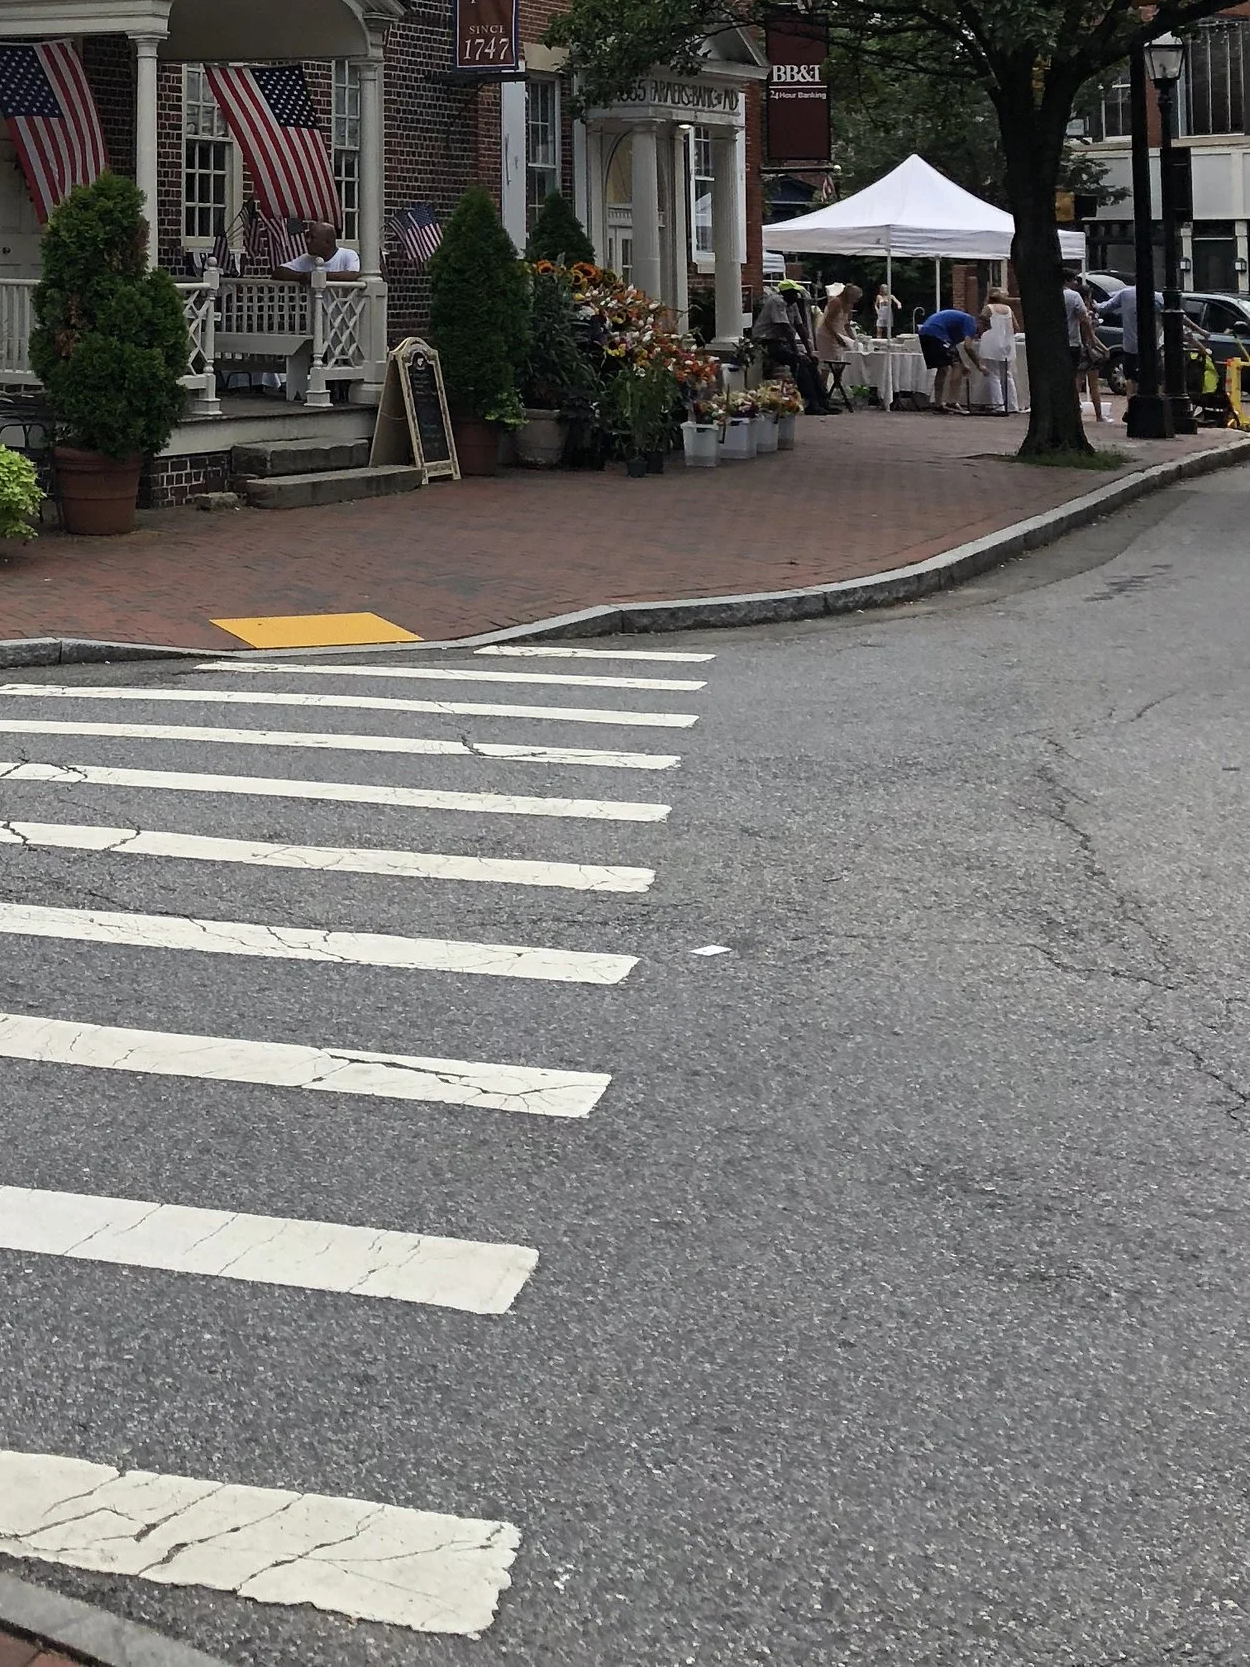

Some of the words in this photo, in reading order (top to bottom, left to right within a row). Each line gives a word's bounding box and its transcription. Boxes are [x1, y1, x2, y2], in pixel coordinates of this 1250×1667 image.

[469, 24, 505, 34] SINCE
[463, 37, 510, 60] 1747
[771, 64, 821, 83] BB&T
[770, 90, 779, 100] 24
[779, 91, 797, 99] Hour
[797, 91, 827, 100] Banking
